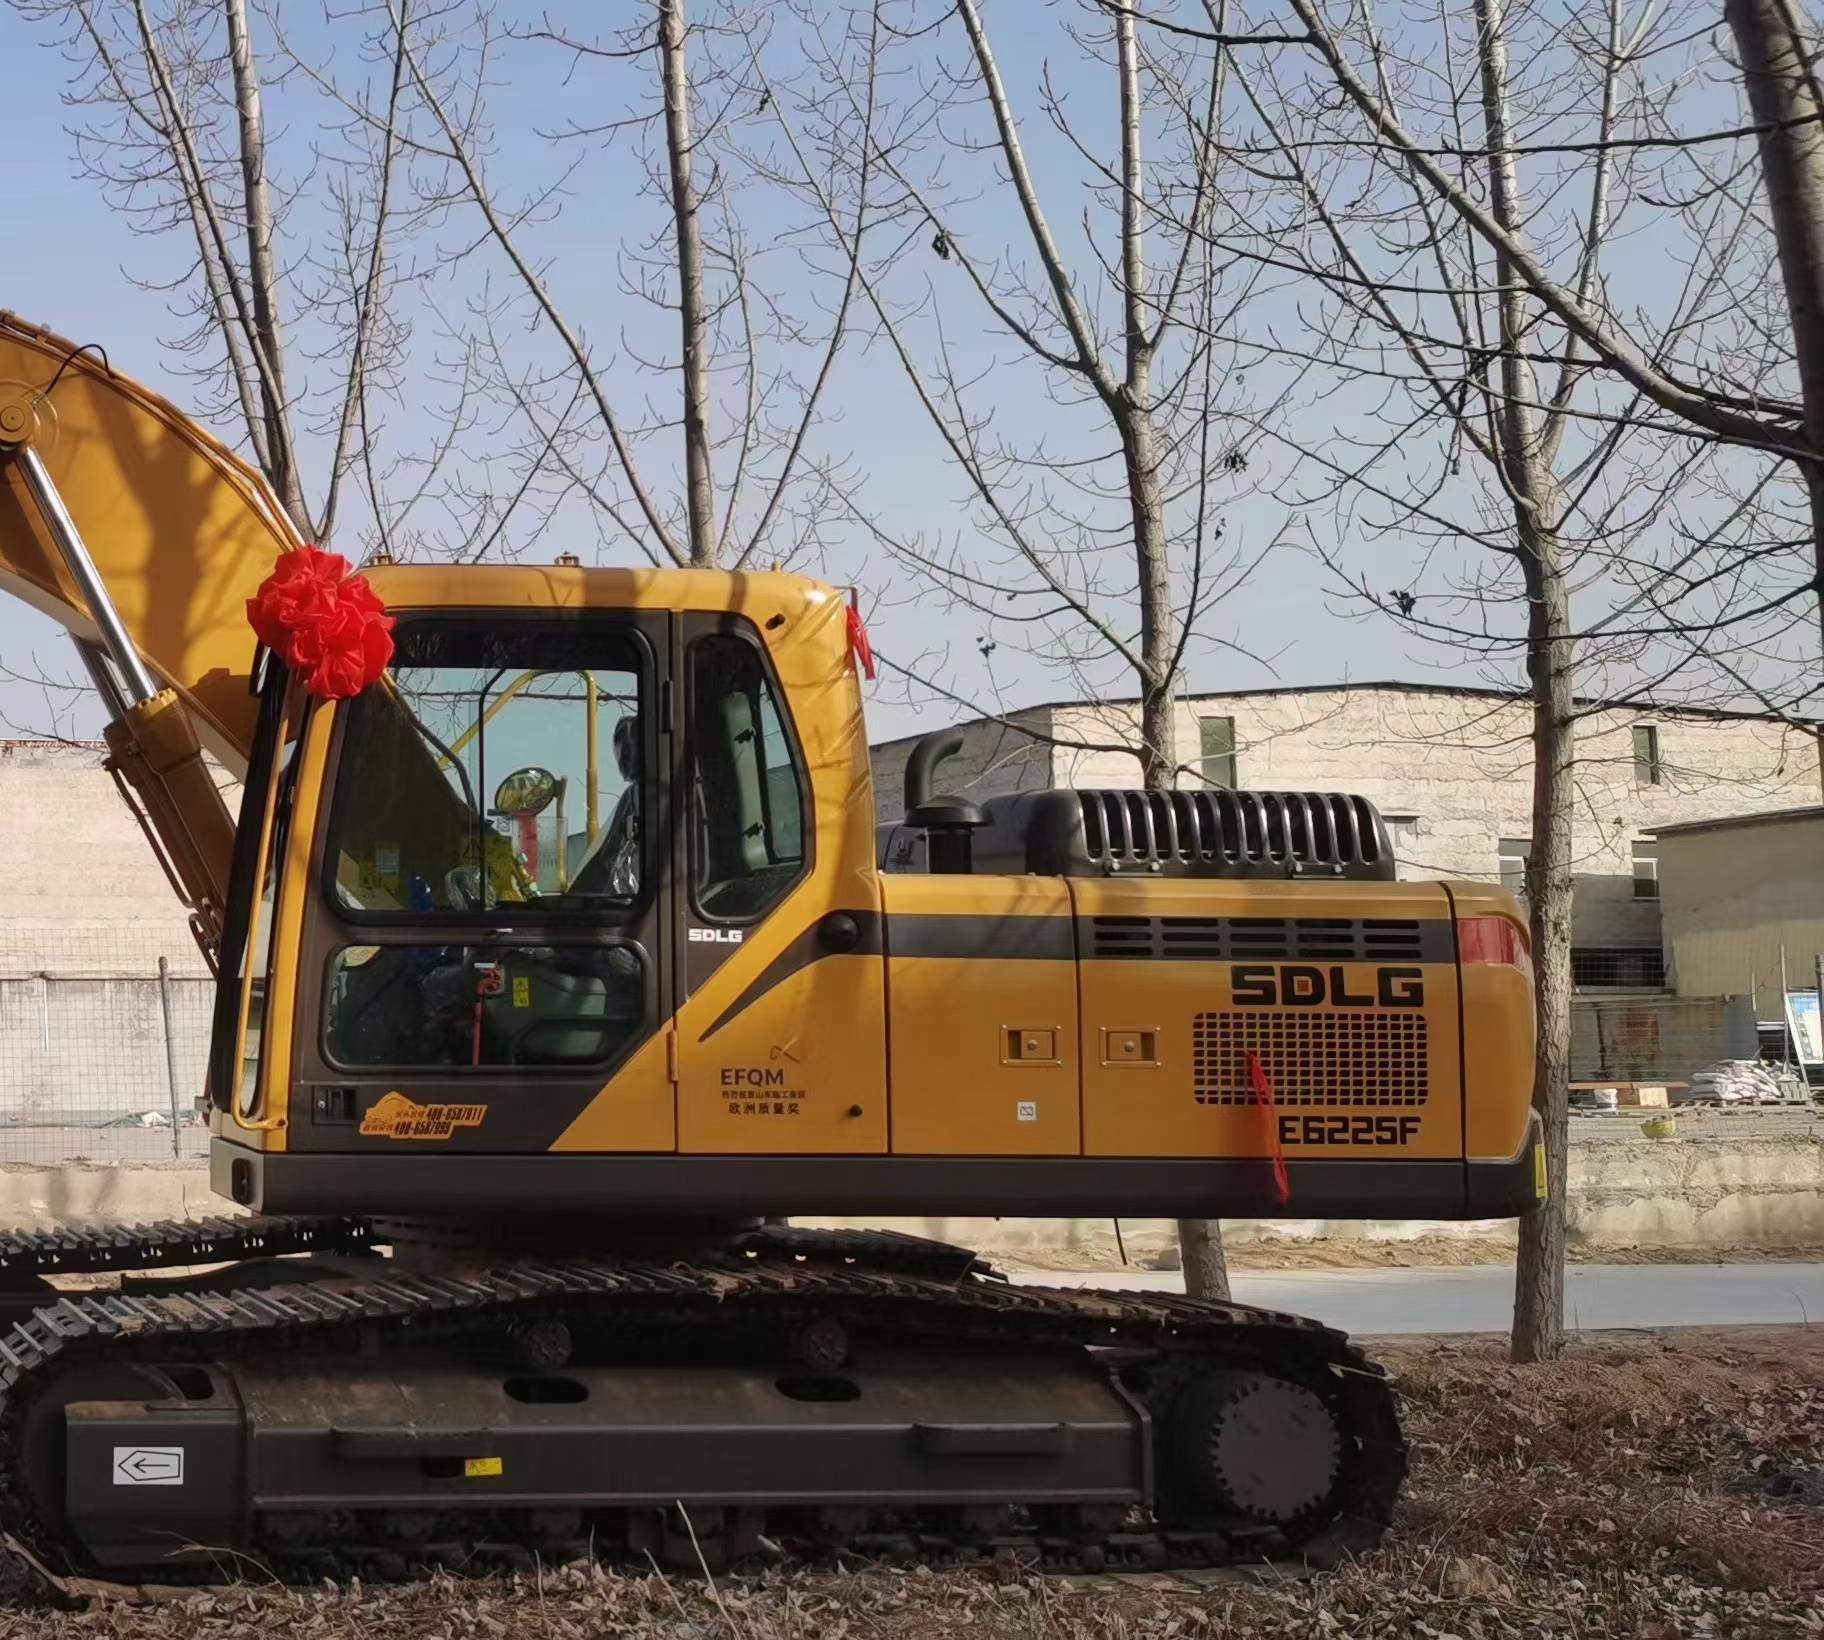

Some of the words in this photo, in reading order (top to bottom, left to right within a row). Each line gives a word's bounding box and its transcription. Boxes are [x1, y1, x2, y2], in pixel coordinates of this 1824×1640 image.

[688, 928, 743, 943] SDLG
[1231, 965, 1424, 1007] SDLG
[721, 1068, 784, 1087] EFQM
[1278, 1115, 1422, 1145] E6225F
